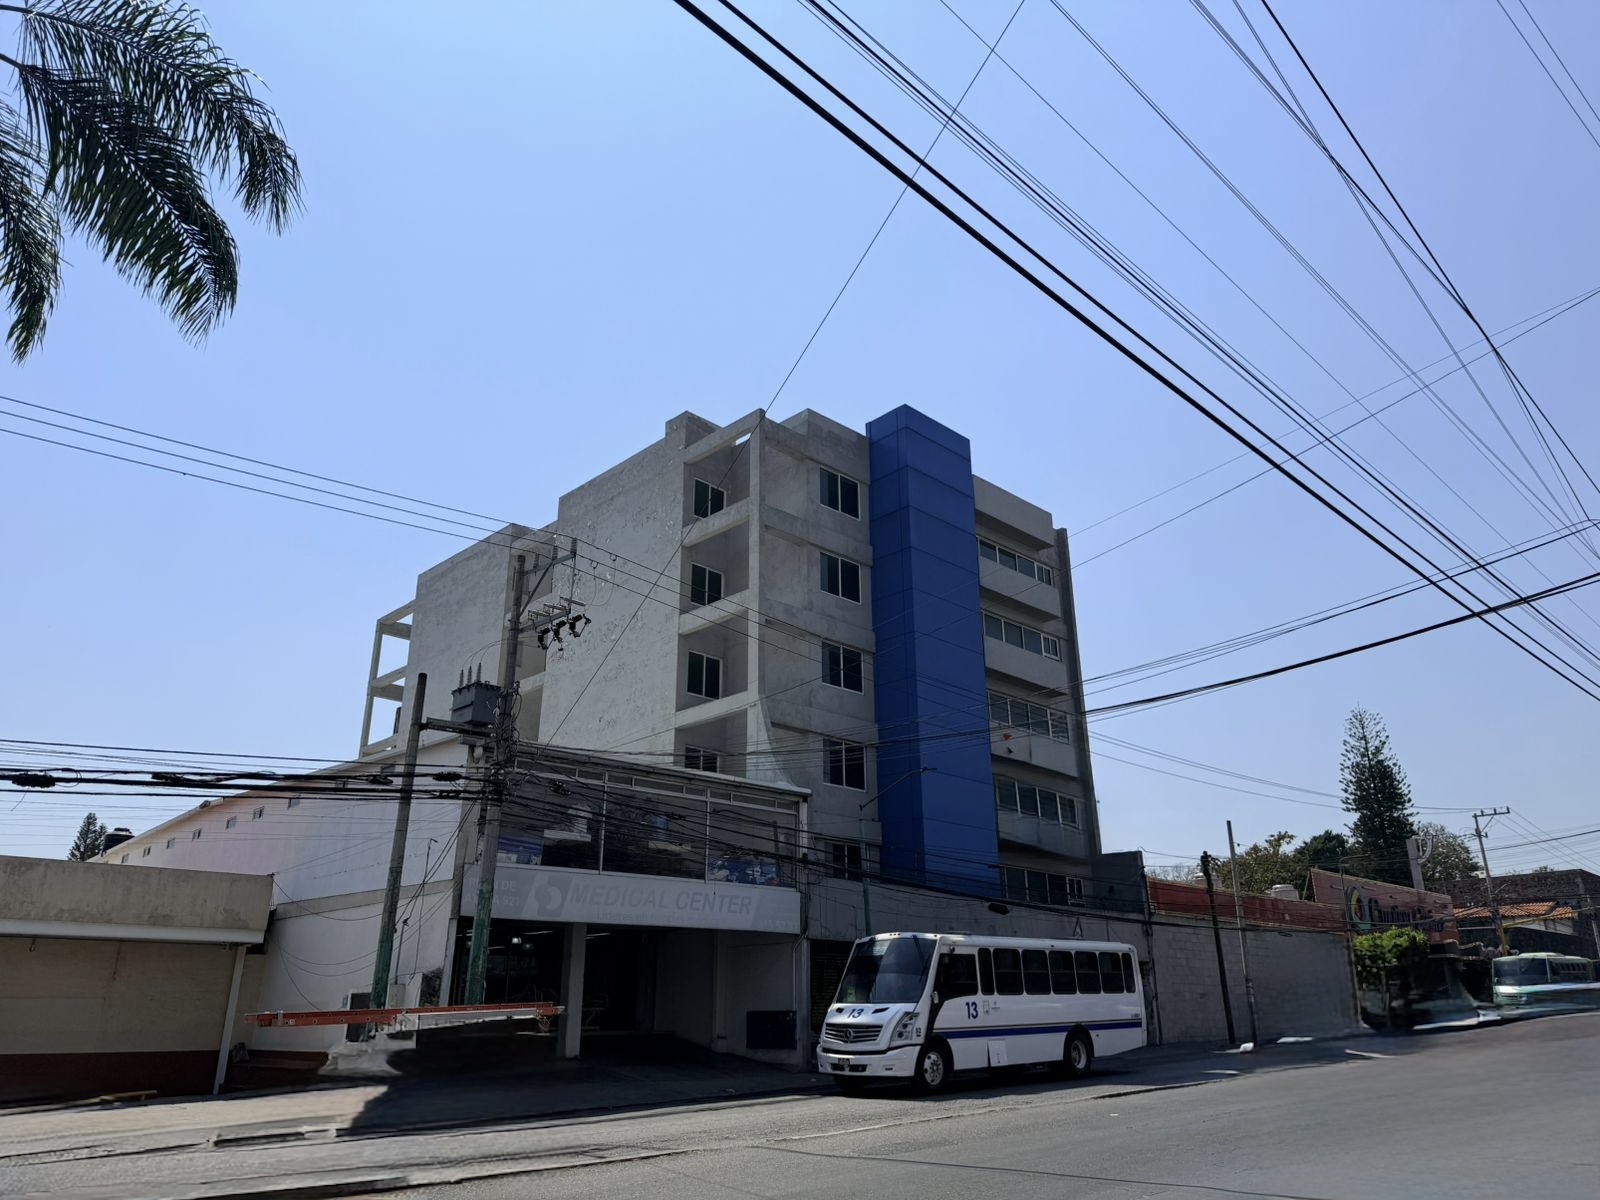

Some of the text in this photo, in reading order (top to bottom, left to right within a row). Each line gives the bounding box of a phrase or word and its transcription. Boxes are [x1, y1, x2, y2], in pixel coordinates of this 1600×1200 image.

[501, 880, 517, 892] DE
[569, 883, 752, 915] MEDICAL CENTER
[847, 1008, 864, 1019] 13
[965, 1001, 979, 1020] 13
